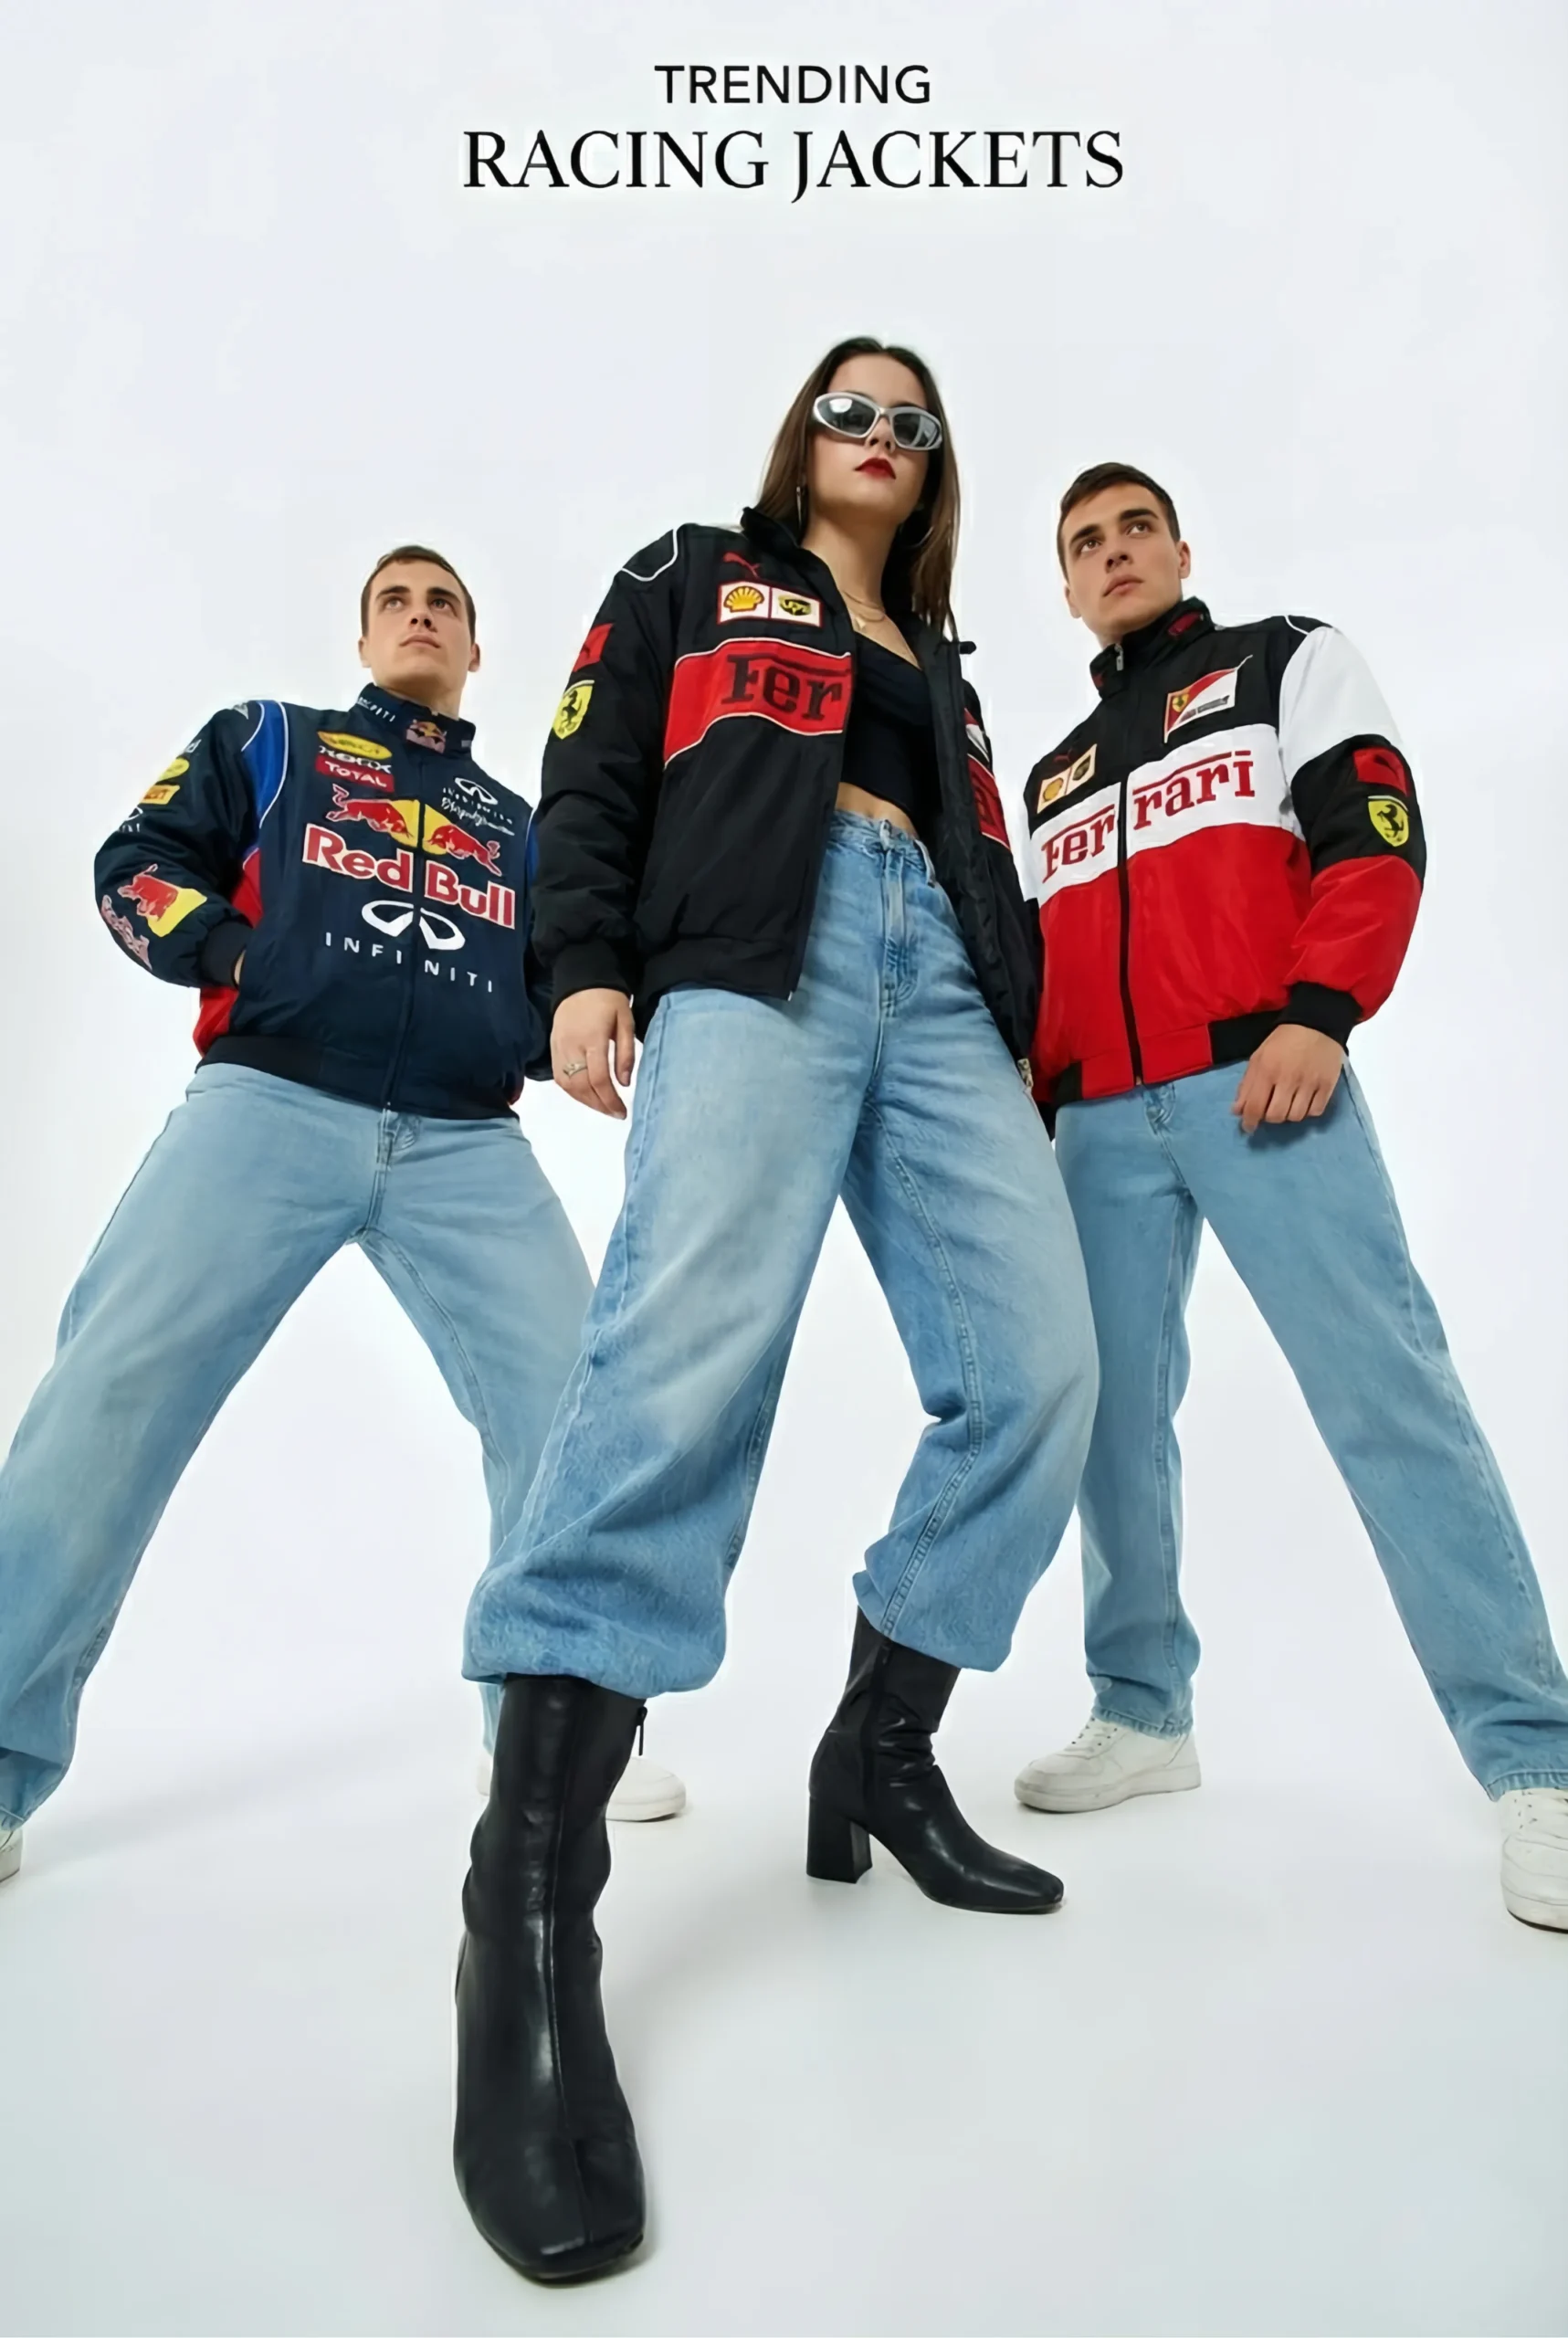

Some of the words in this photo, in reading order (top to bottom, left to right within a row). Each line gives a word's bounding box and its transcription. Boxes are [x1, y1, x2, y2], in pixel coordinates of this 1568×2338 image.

[324, 761, 387, 787] TOTAL
[302, 823, 414, 893] Red
[424, 860, 515, 930] Bull
